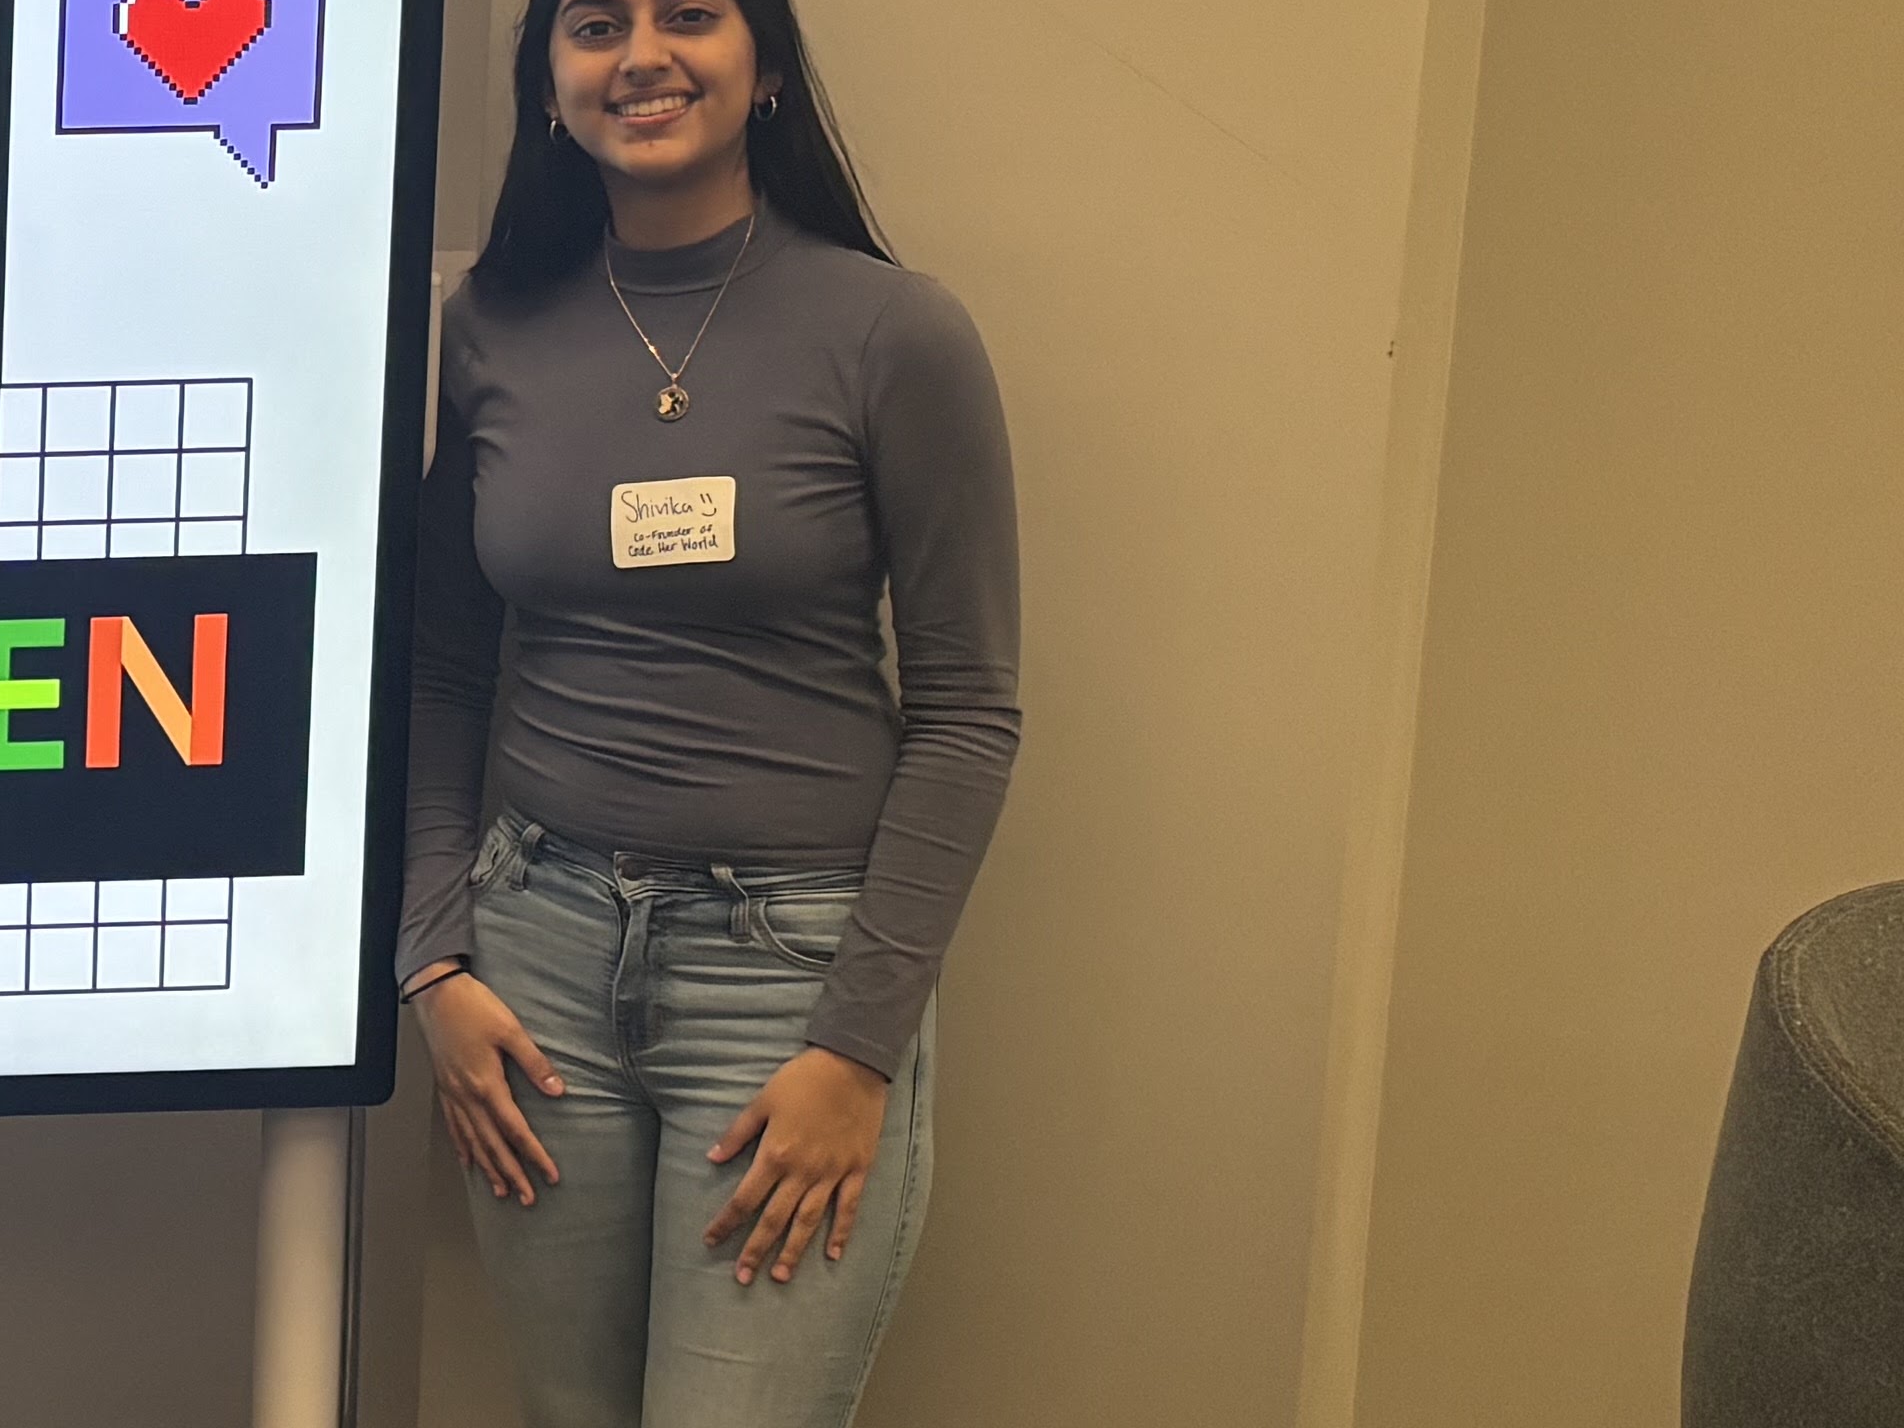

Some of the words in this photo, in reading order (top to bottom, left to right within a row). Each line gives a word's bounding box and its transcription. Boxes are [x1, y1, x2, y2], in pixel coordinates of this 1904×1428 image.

[621, 490, 693, 523] Shivika
[628, 545, 654, 557] Code
[658, 542, 678, 553] Her
[681, 534, 719, 551] World
